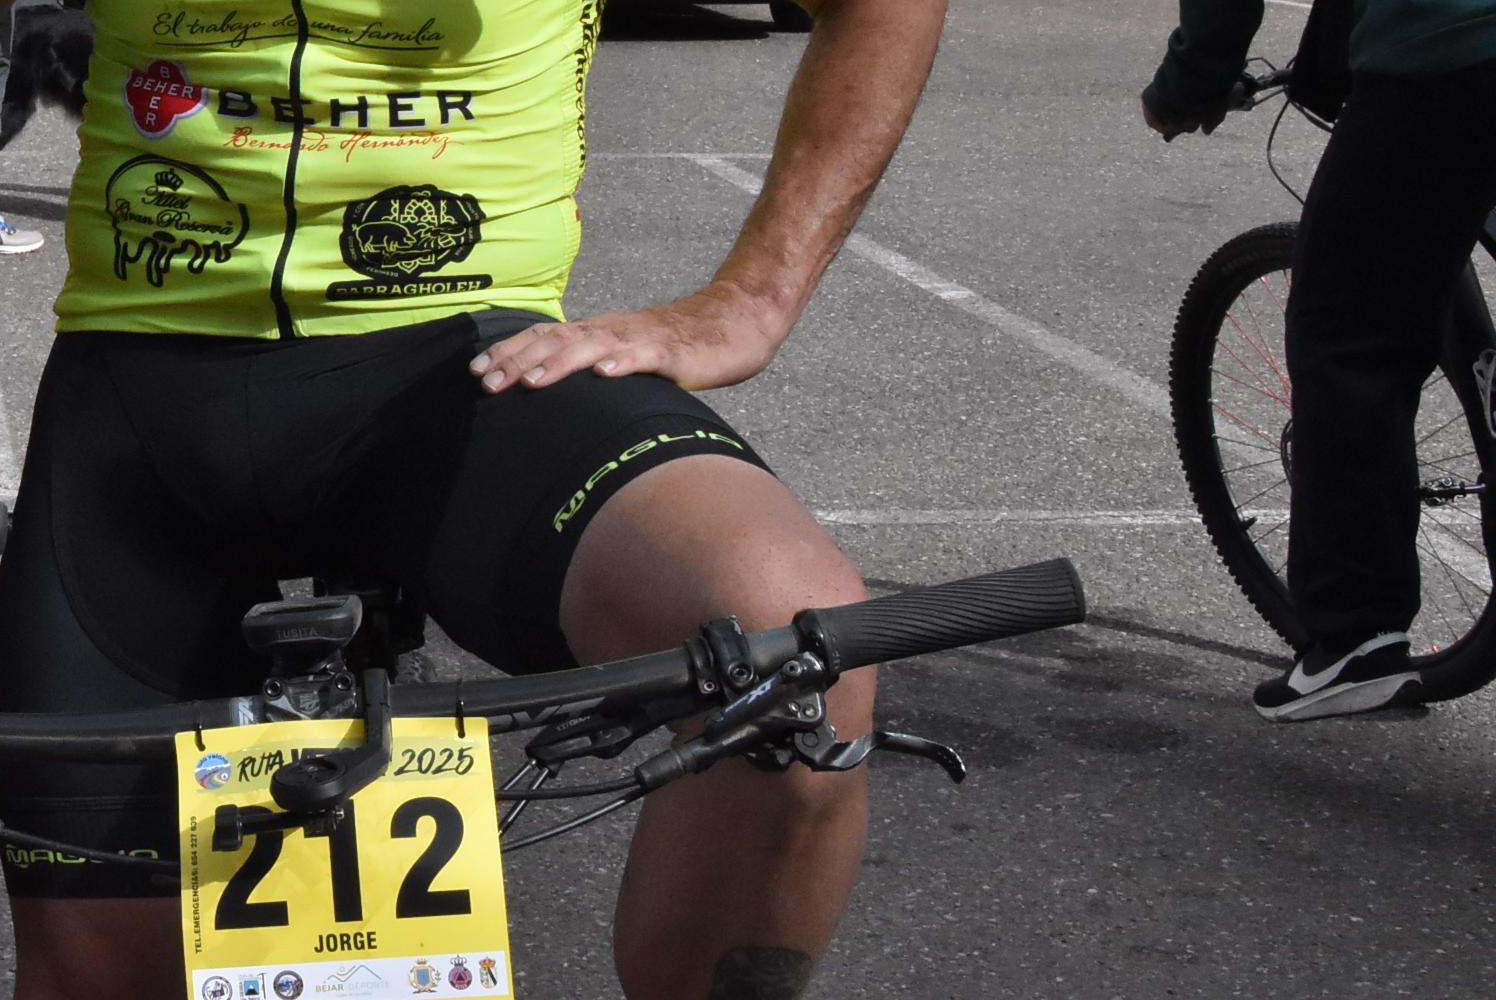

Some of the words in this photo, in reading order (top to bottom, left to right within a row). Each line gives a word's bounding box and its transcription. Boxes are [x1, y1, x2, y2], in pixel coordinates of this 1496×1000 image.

[153, 10, 186, 37] El
[186, 10, 266, 48] trabajo
[309, 20, 354, 35] una
[346, 18, 445, 46] familia
[132, 76, 194, 99] BEHER
[217, 90, 476, 128] BEHER
[553, 430, 745, 533] MAGLIA
[238, 750, 285, 782] RUTA
[394, 746, 475, 776] 2025
[214, 796, 472, 931] 212
[314, 931, 378, 953] JORGE
